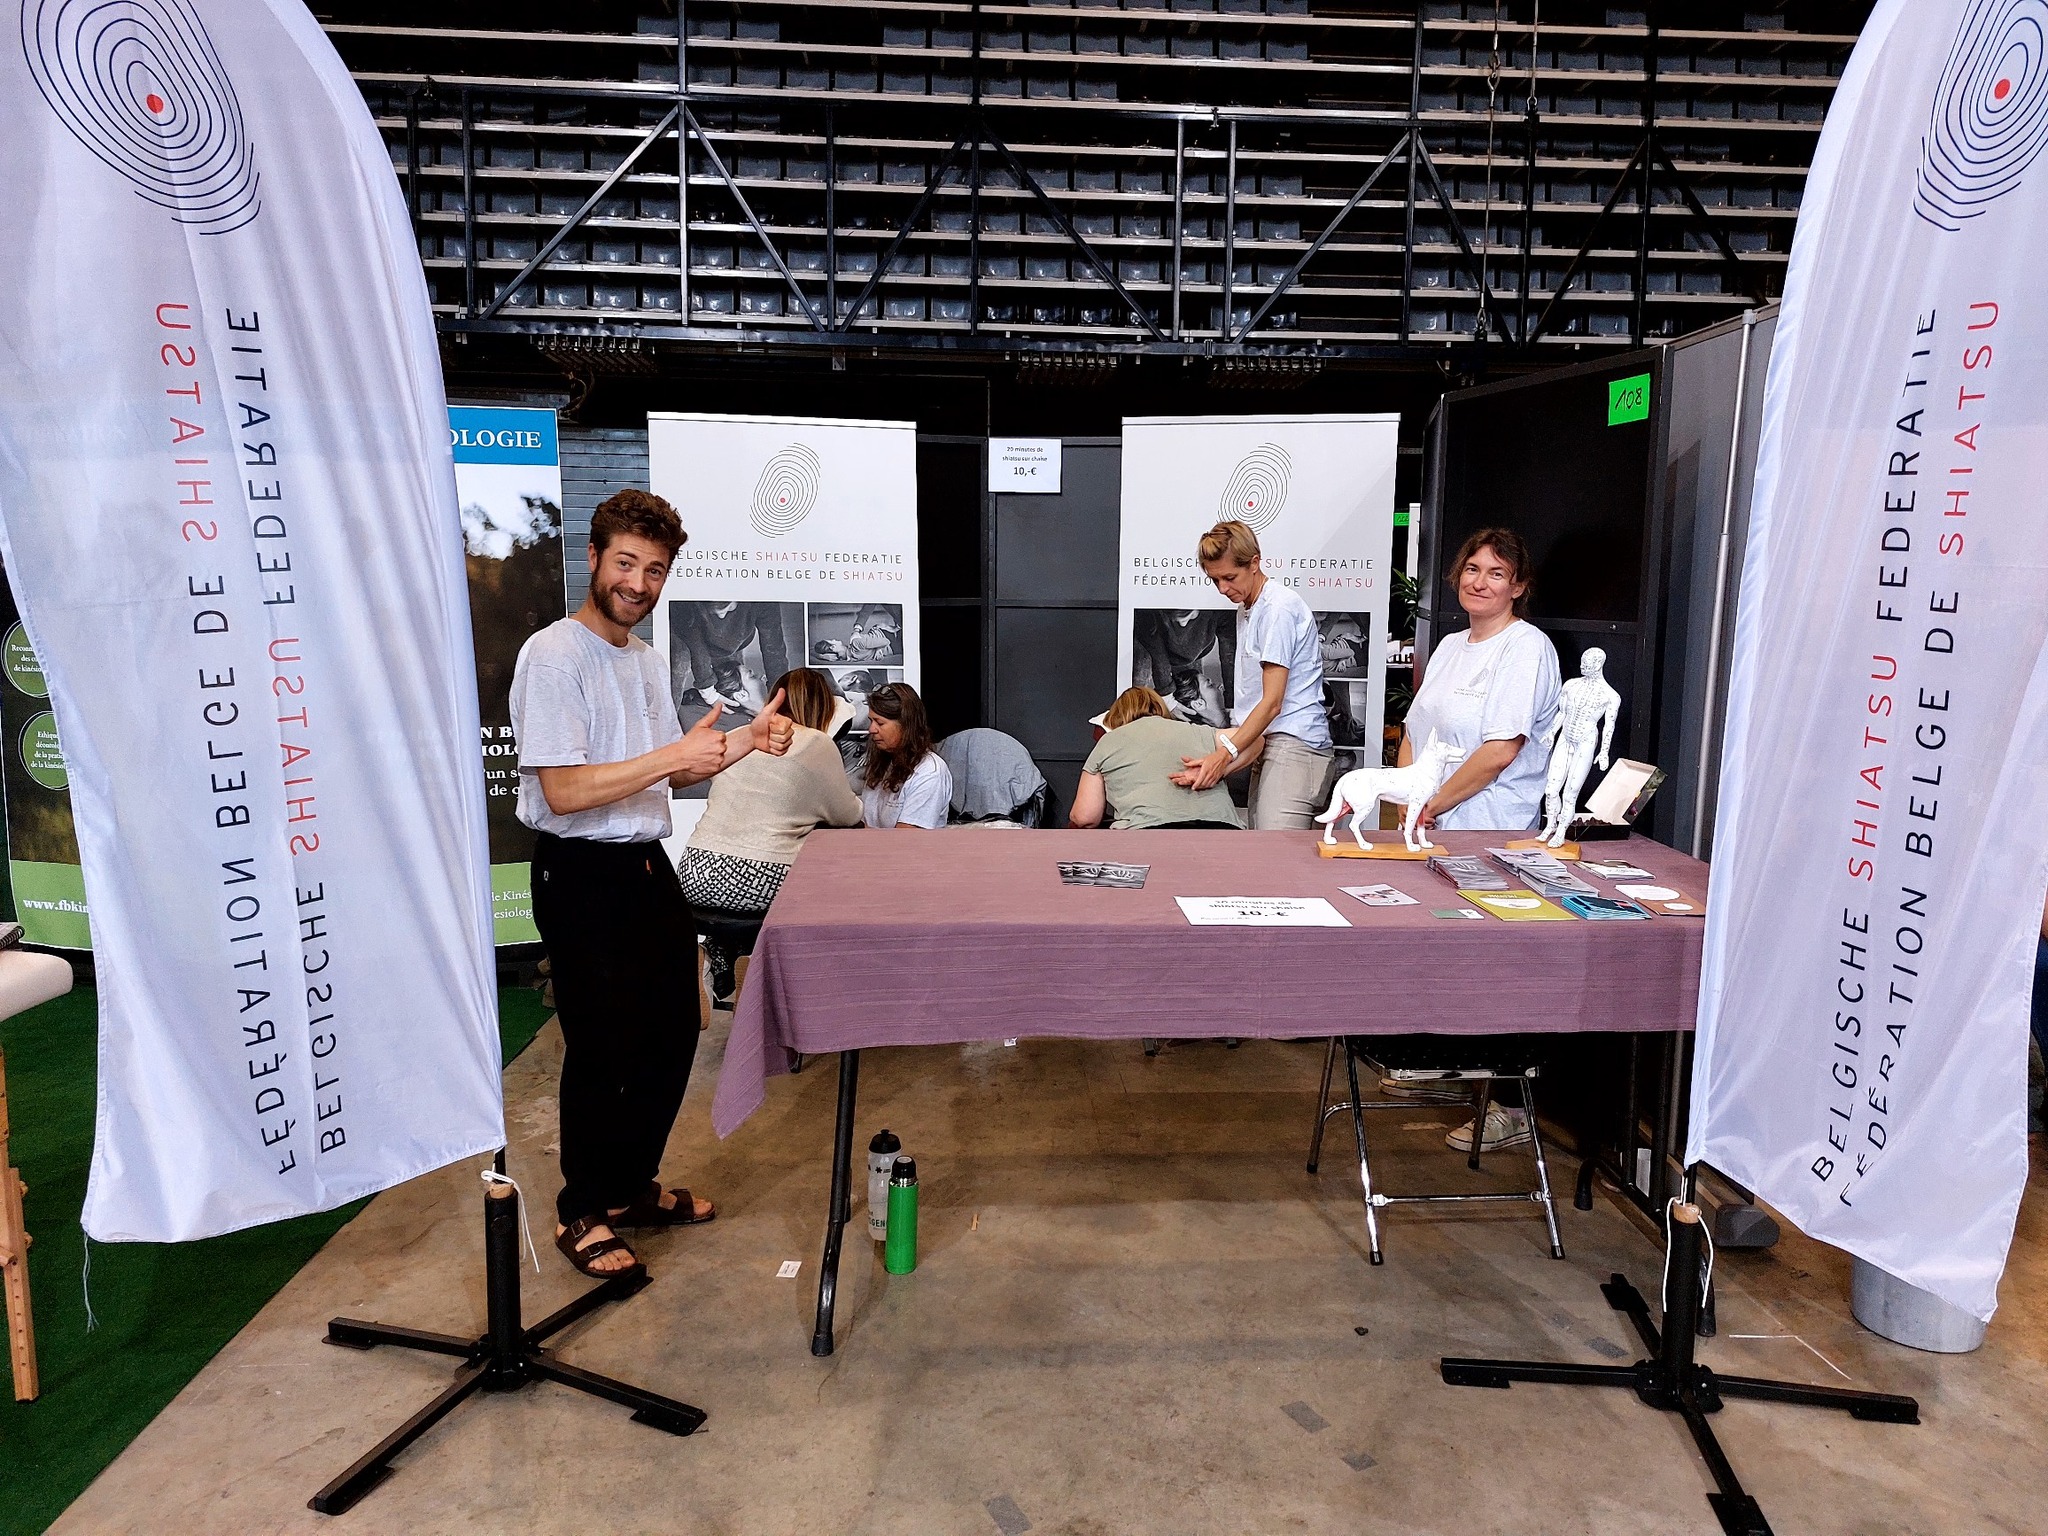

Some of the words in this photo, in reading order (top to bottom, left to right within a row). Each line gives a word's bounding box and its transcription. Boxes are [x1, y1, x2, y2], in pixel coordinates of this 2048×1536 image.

[1614, 387, 1643, 411] 108
[1939, 301, 2000, 557] SHIATSU
[677, 550, 748, 561] ELGISCHE
[755, 551, 818, 562] SHIATSU
[825, 553, 902, 564] FEDERATIE
[1290, 558, 1374, 570] FEDERATIE
[767, 569, 811, 580] BELGE
[819, 570, 836, 580] DE
[843, 571, 903, 581] SHIATSU
[1133, 574, 1212, 586] FÉDÉRATIO
[1283, 577, 1300, 587] DE
[1308, 578, 1373, 588] SHIATSU
[1924, 590, 1960, 655] DE
[22, 664, 42, 672] kinésio
[37, 731, 58, 740] Ethiqu
[1811, 907, 1870, 1182] BELGISCHE
[1847, 655, 1898, 882] SHIATSU
[1876, 308, 1937, 622] FEDERATIE
[1905, 687, 1951, 858] BELGE
[489, 784, 507, 796] de
[502, 890, 532, 901] Kinés
[23, 899, 89, 913] www.fbkin
[493, 907, 533, 919] esiolog
[1839, 886, 1928, 1208] FÉDÉRATION
